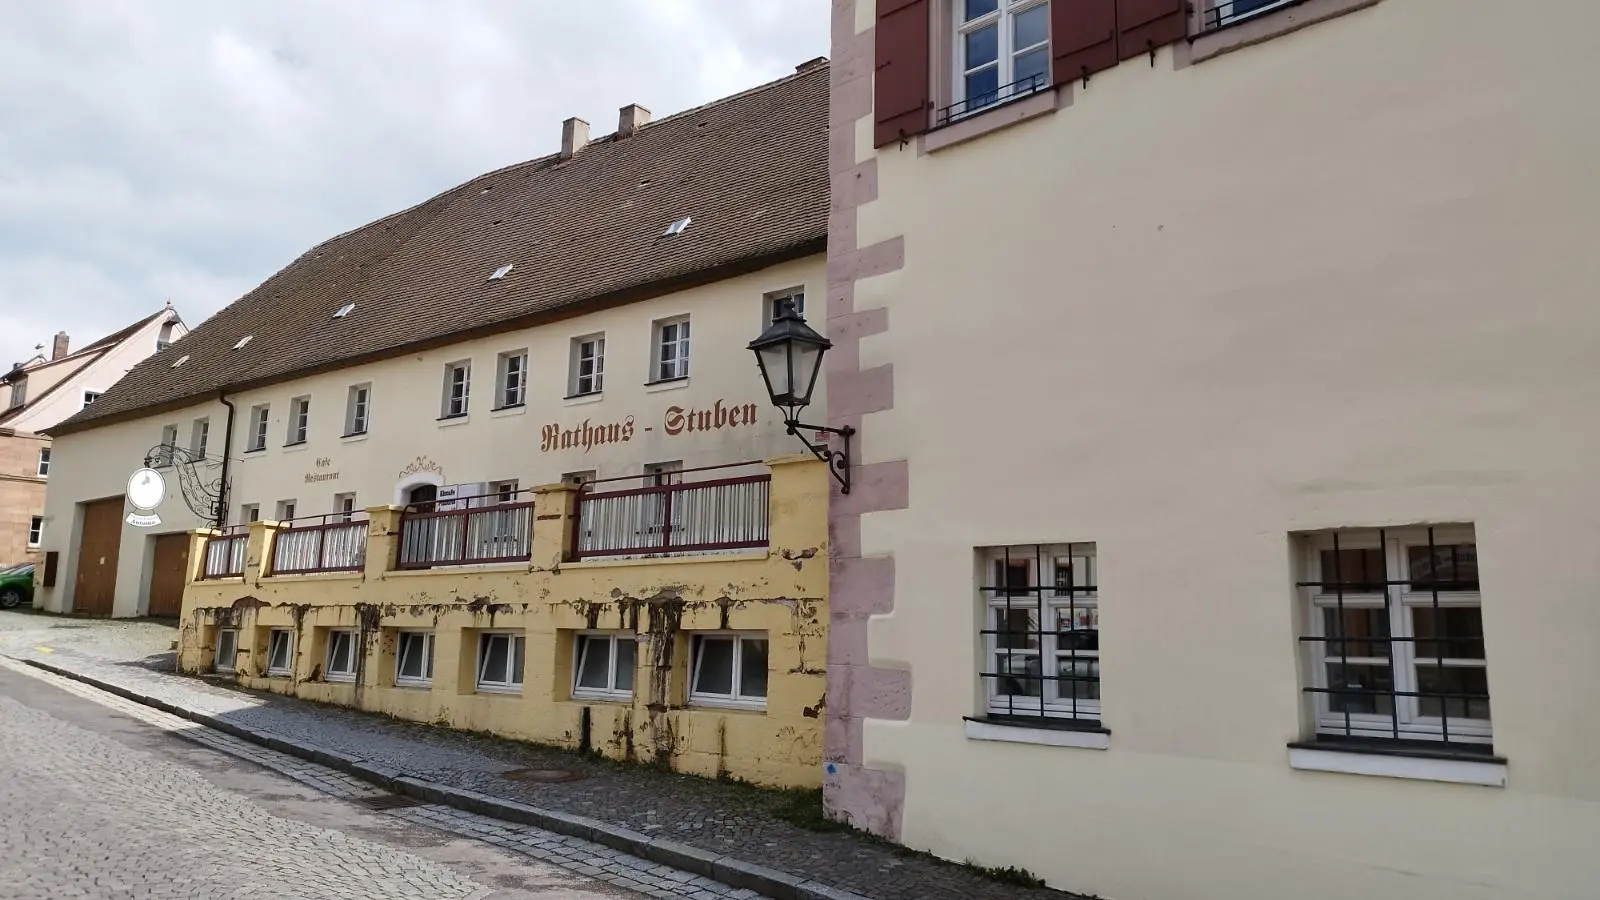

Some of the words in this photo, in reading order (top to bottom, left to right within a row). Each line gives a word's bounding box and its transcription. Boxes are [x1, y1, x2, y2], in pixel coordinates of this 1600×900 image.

[541, 414, 635, 454] Rathaus
[664, 398, 758, 436] Stuben
[304, 471, 340, 484] Restaurant
